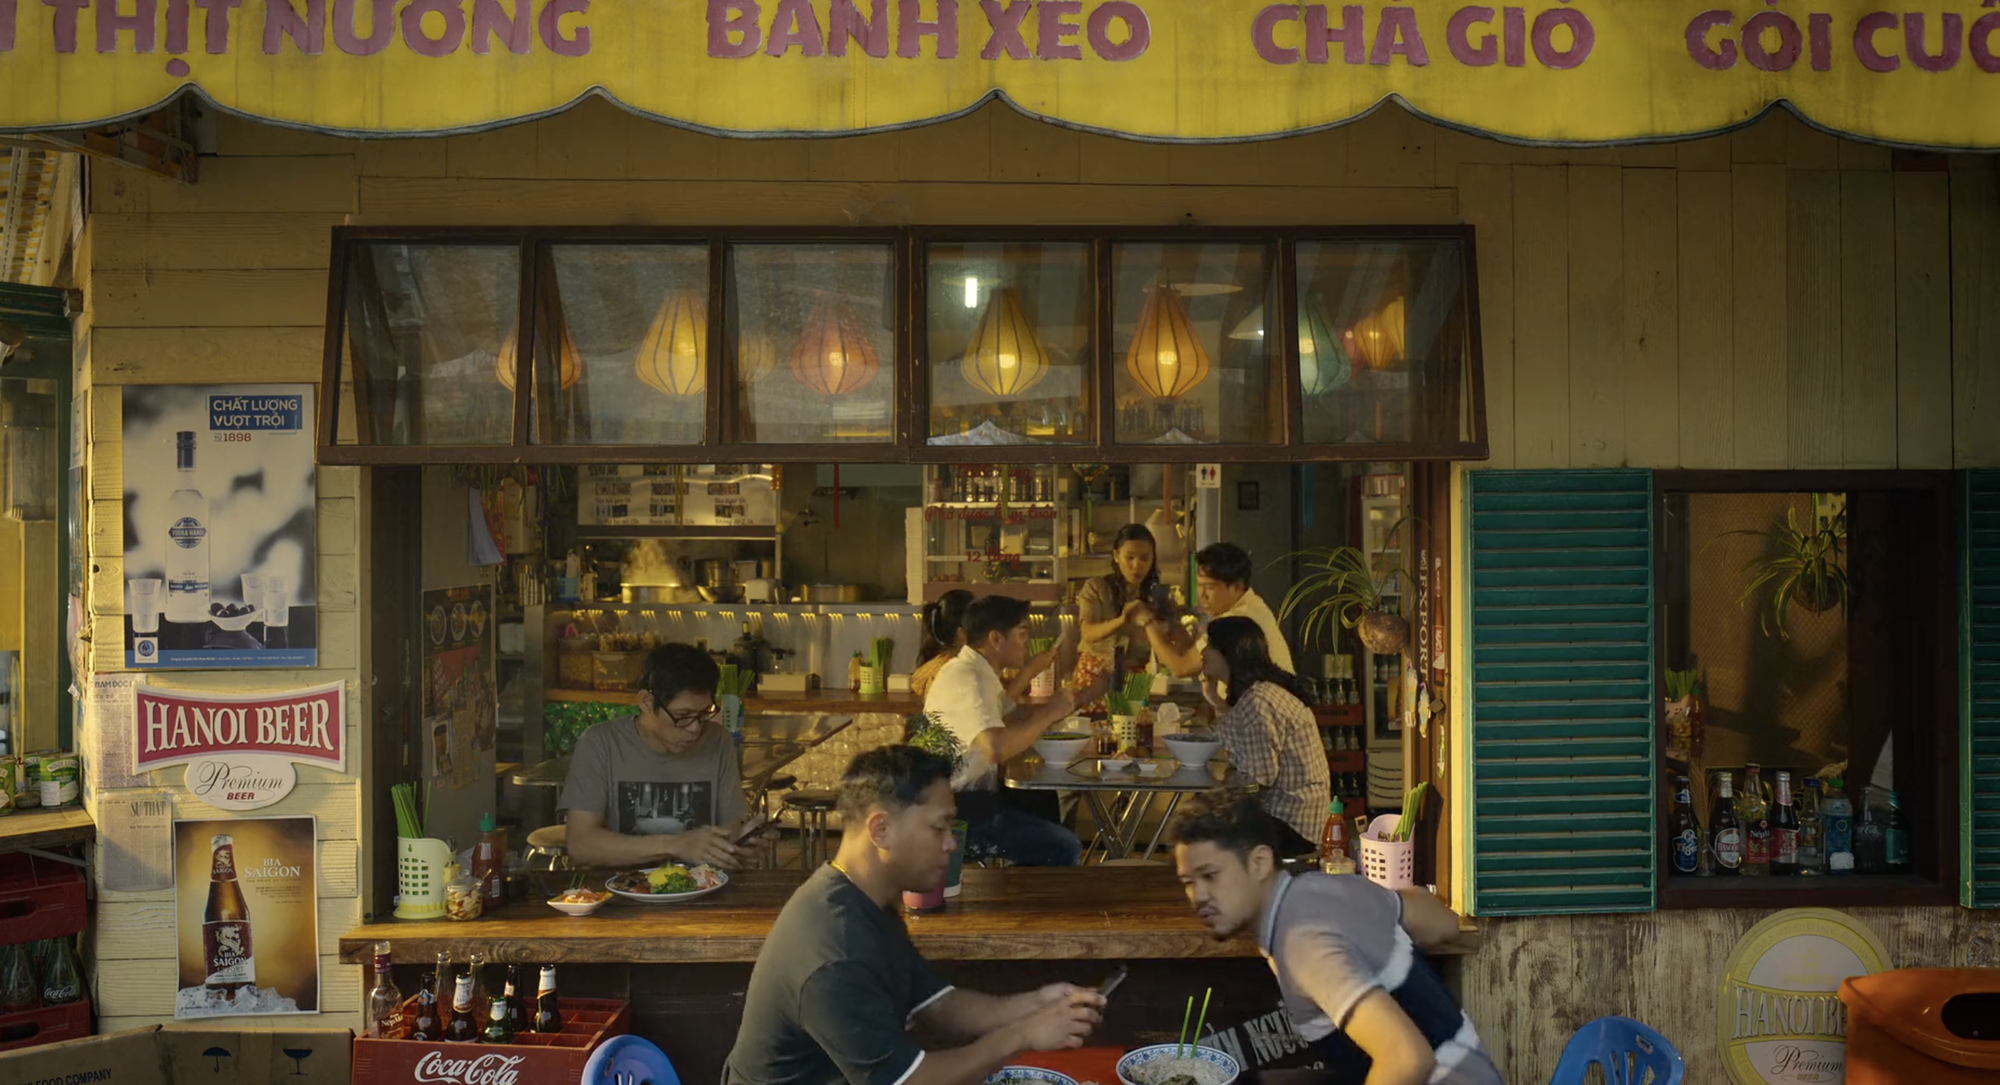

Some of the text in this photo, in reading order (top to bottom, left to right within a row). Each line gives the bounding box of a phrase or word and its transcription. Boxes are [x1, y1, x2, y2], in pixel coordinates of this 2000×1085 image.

[213, 396, 298, 414] CHẤT LƯỢNG
[213, 411, 285, 429] VƯỢT TRỘI
[223, 432, 252, 442] 1898
[966, 550, 981, 562] 12
[1419, 572, 1429, 682] EXPORT
[143, 699, 335, 754] HANOI BEER
[194, 760, 285, 797] Premium
[227, 791, 255, 801] BEER
[263, 858, 281, 866] BIA
[244, 866, 301, 878] SAIGON
[213, 957, 247, 967] SAIGON
[1732, 984, 1814, 1040] HANOI
[413, 1050, 528, 1085] Coca-Cola
[1770, 1044, 1844, 1075] Premium
[65, 1068, 112, 1085] COMPANY
[1796, 1073, 1820, 1082] BEER
